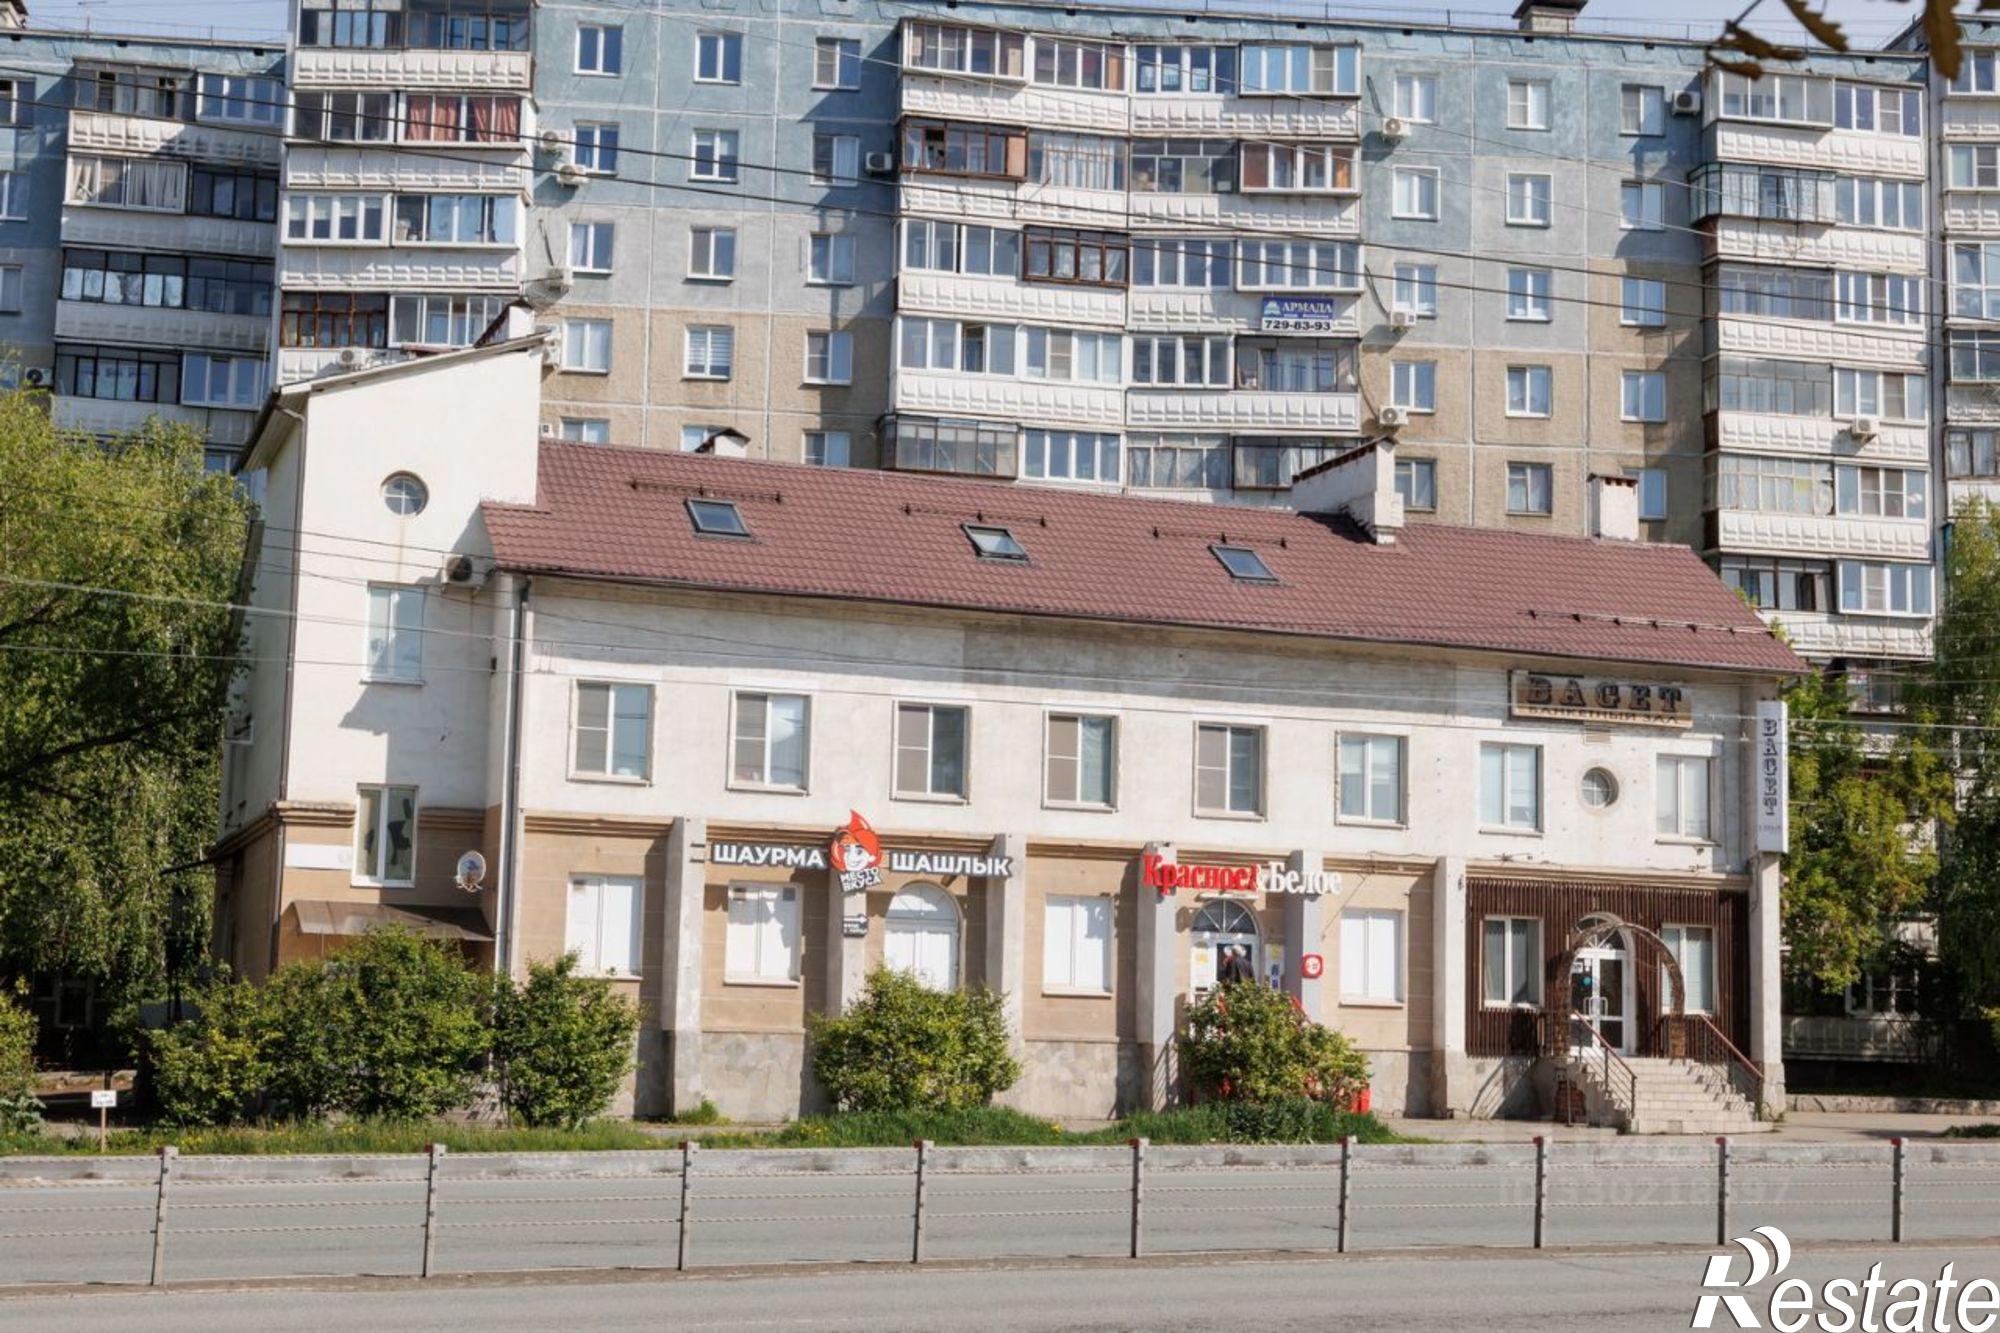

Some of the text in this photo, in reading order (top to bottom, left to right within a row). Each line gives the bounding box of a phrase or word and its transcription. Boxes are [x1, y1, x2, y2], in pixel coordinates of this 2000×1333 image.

[1282, 302, 1332, 313] АРМАДА
[1264, 320, 1331, 331] 729-83-93
[713, 844, 825, 869] ШАУРМА
[892, 853, 1011, 877] ШАШЛЫК
[840, 866, 879, 883] МЕСТО
[842, 875, 882, 892] ВКУСА
